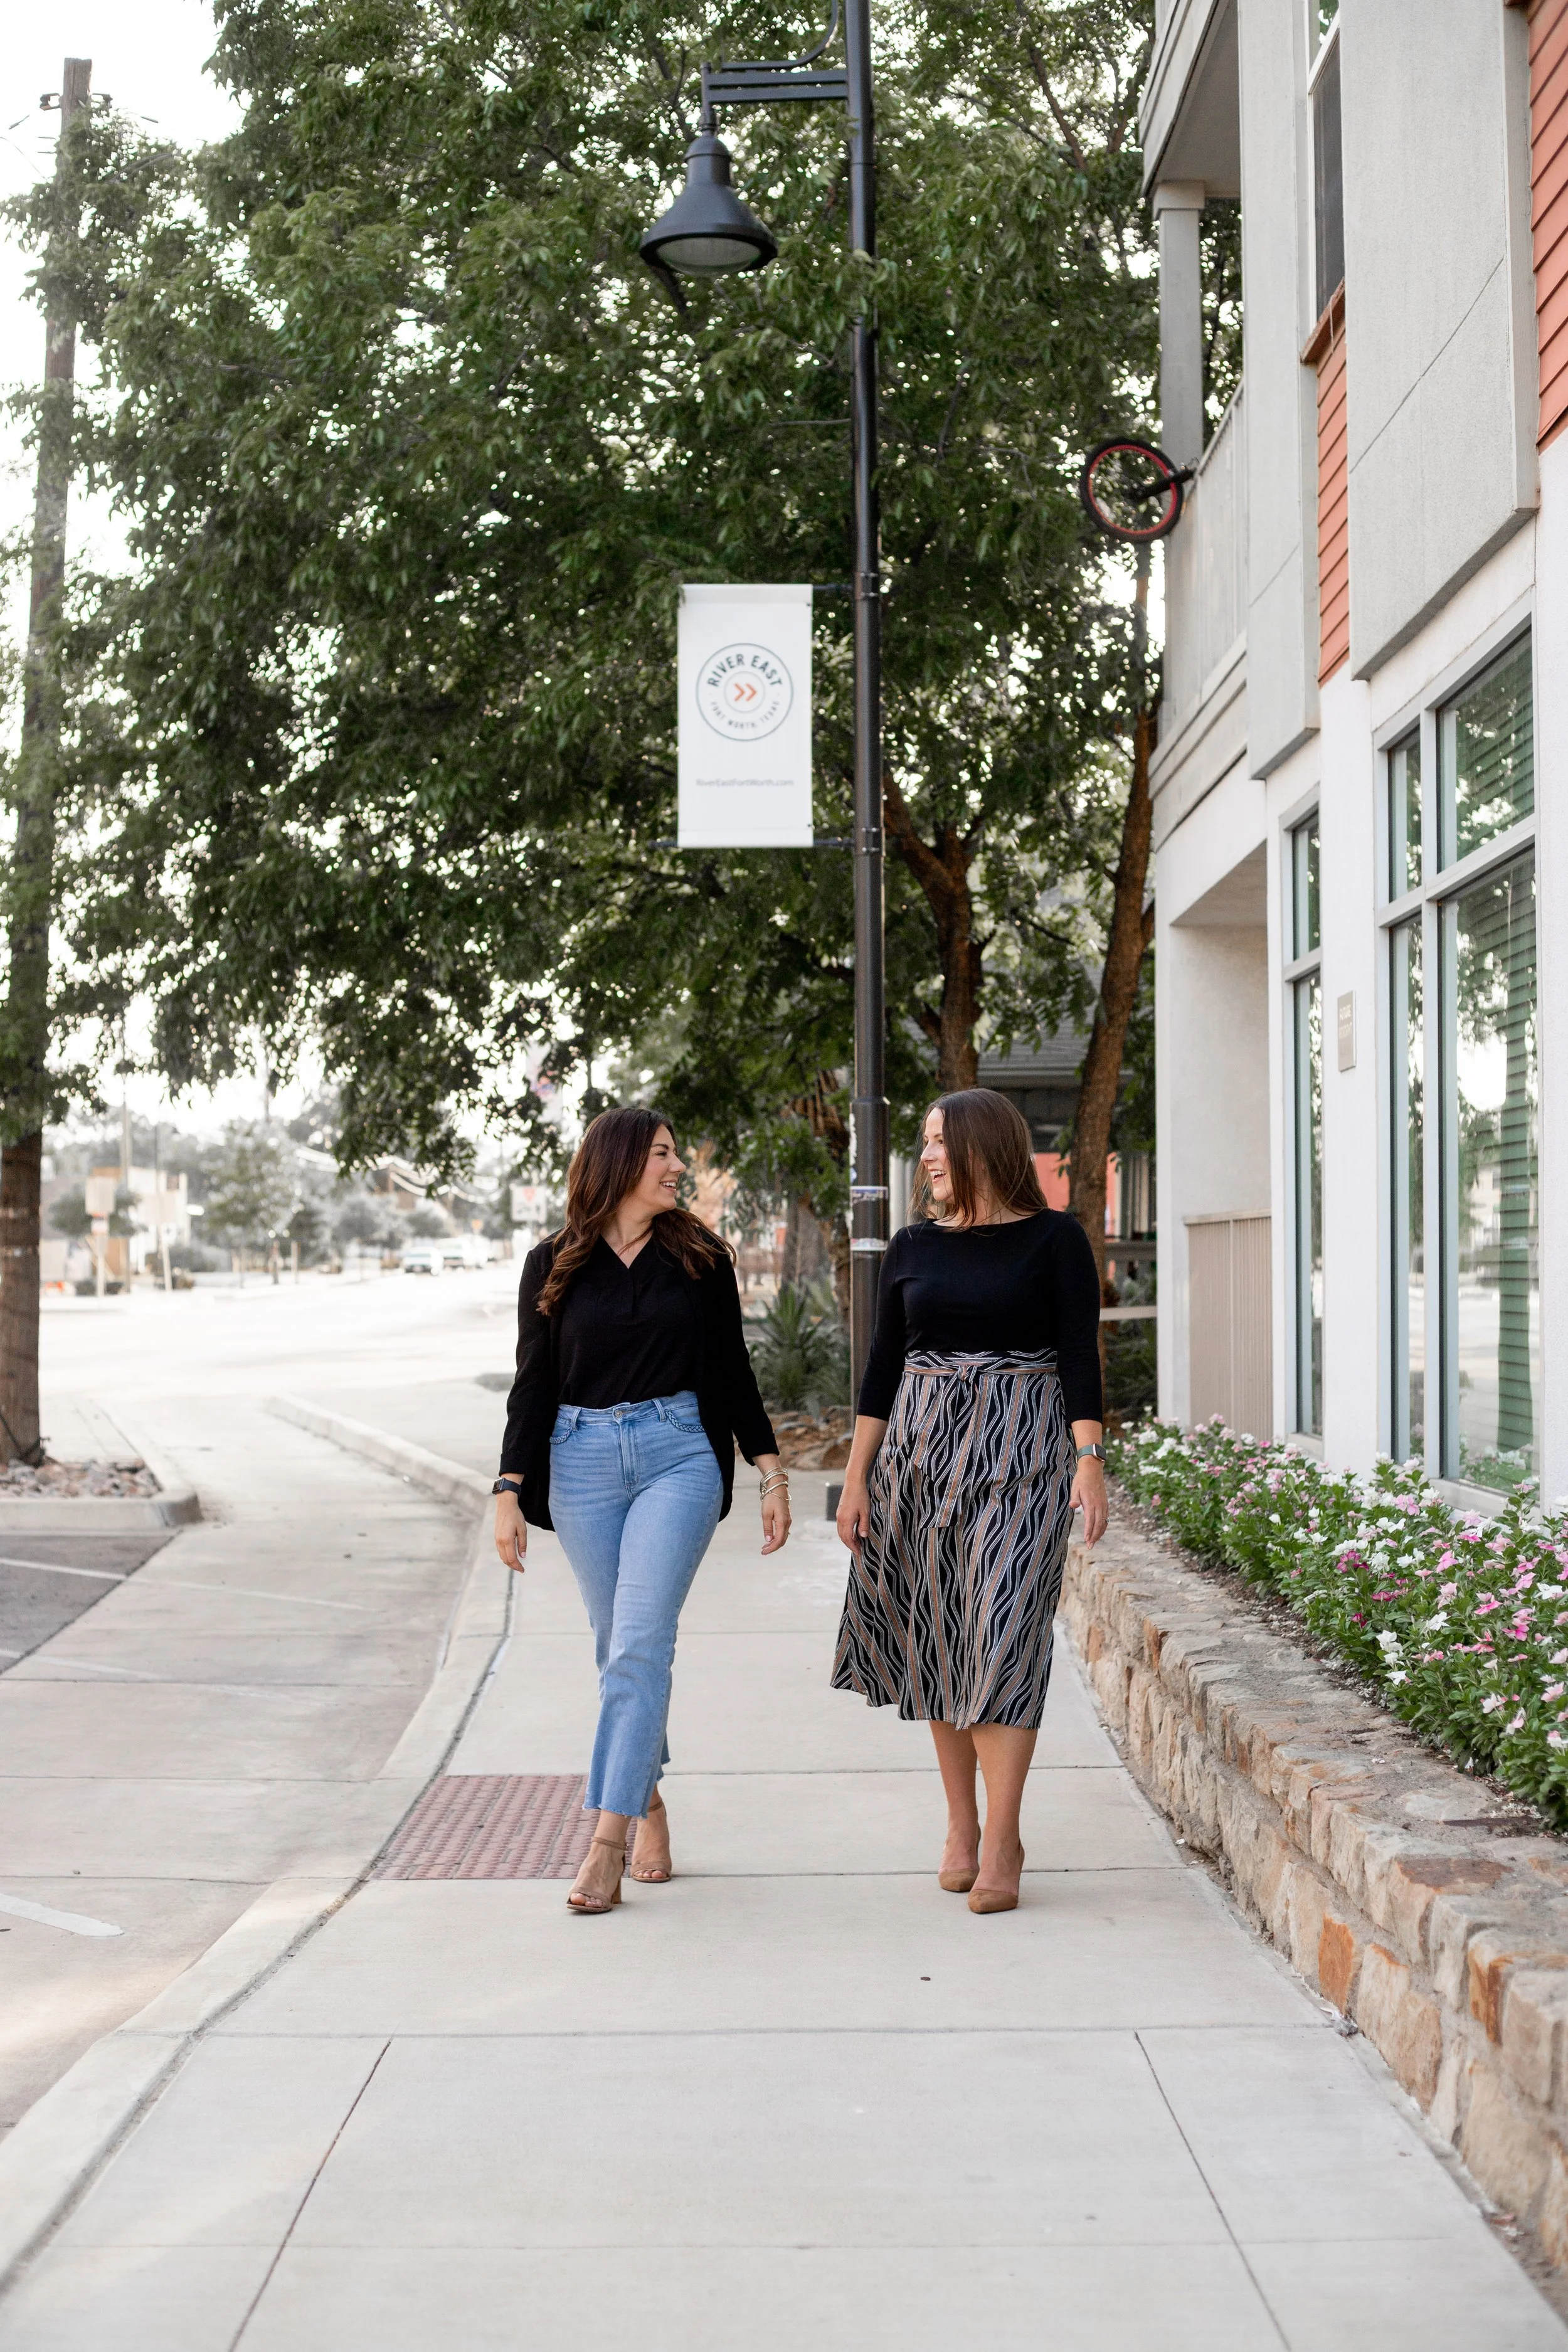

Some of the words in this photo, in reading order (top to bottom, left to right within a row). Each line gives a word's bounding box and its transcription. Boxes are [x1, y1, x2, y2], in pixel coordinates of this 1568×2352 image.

[707, 654, 745, 687] RIVER
[751, 655, 782, 686] EAST
[710, 701, 726, 721] FORT
